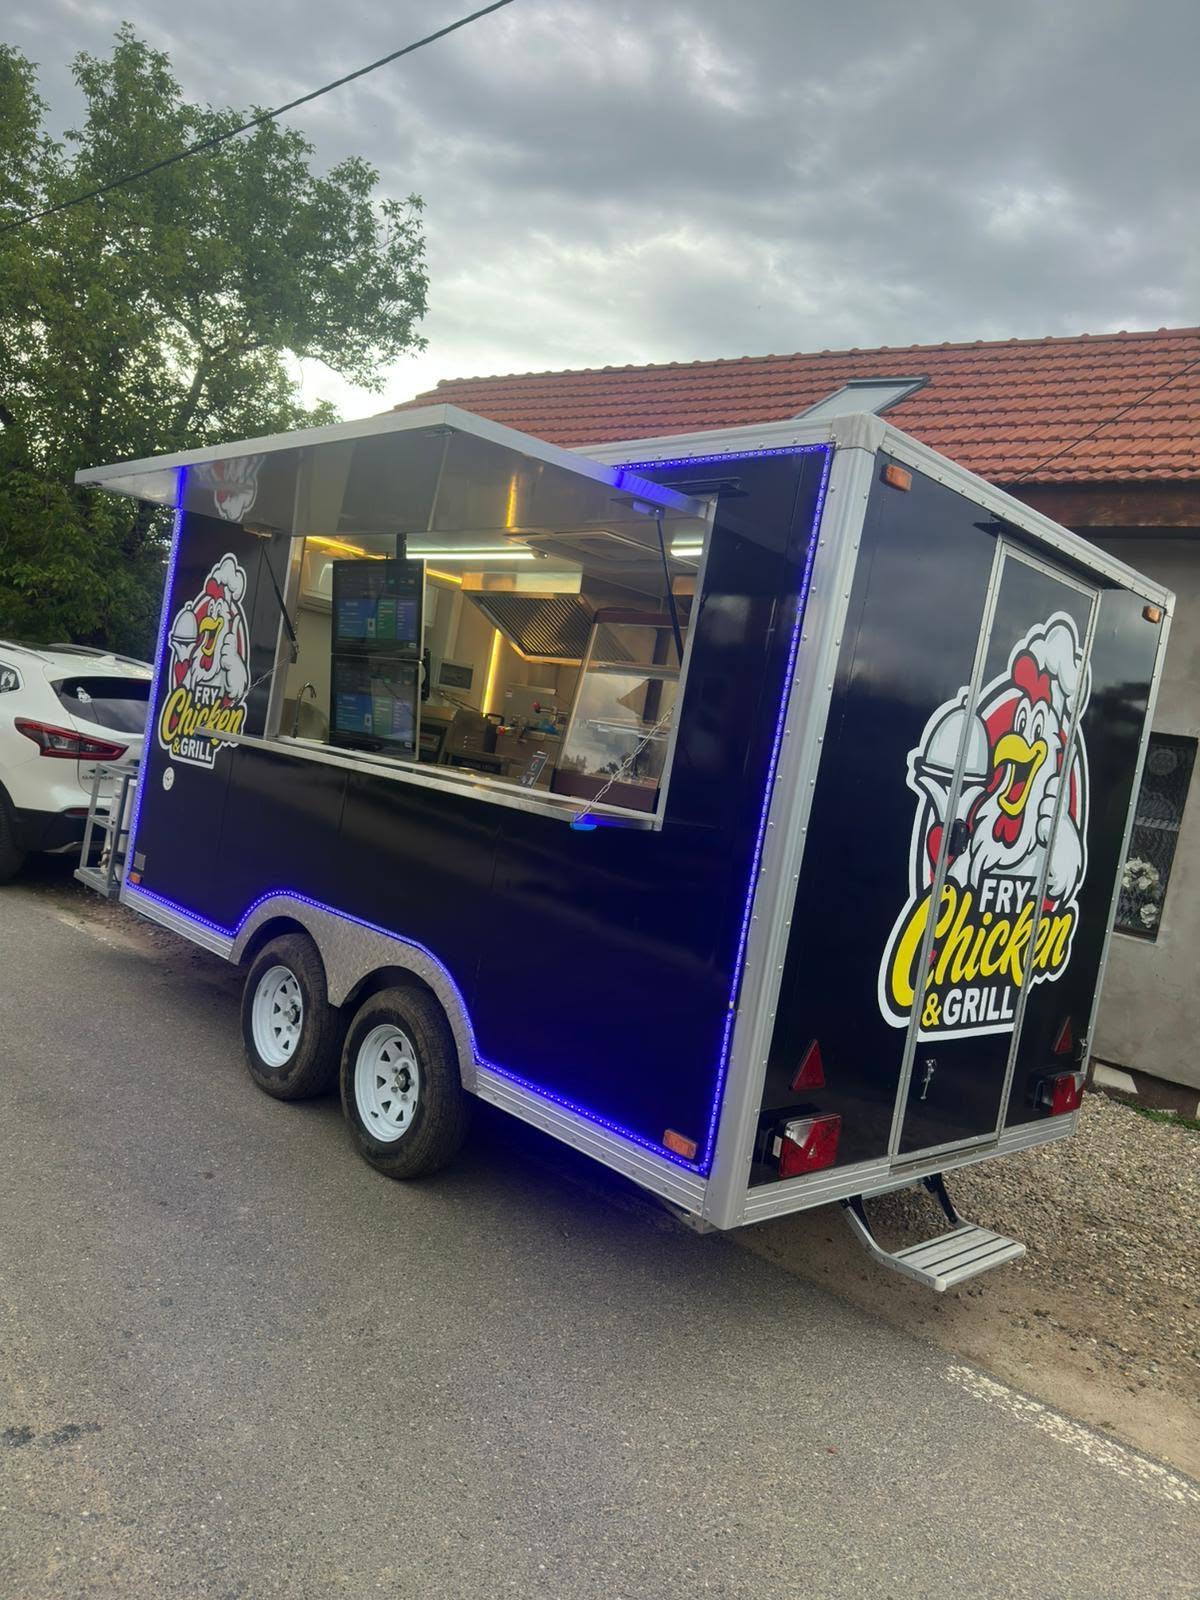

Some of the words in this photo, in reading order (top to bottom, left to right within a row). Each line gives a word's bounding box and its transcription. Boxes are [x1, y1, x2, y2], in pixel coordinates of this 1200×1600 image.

[162, 687, 243, 744] Chicken
[194, 686, 218, 706] FRY
[979, 878, 1031, 914] FRY
[892, 884, 1072, 1007] Chicken
